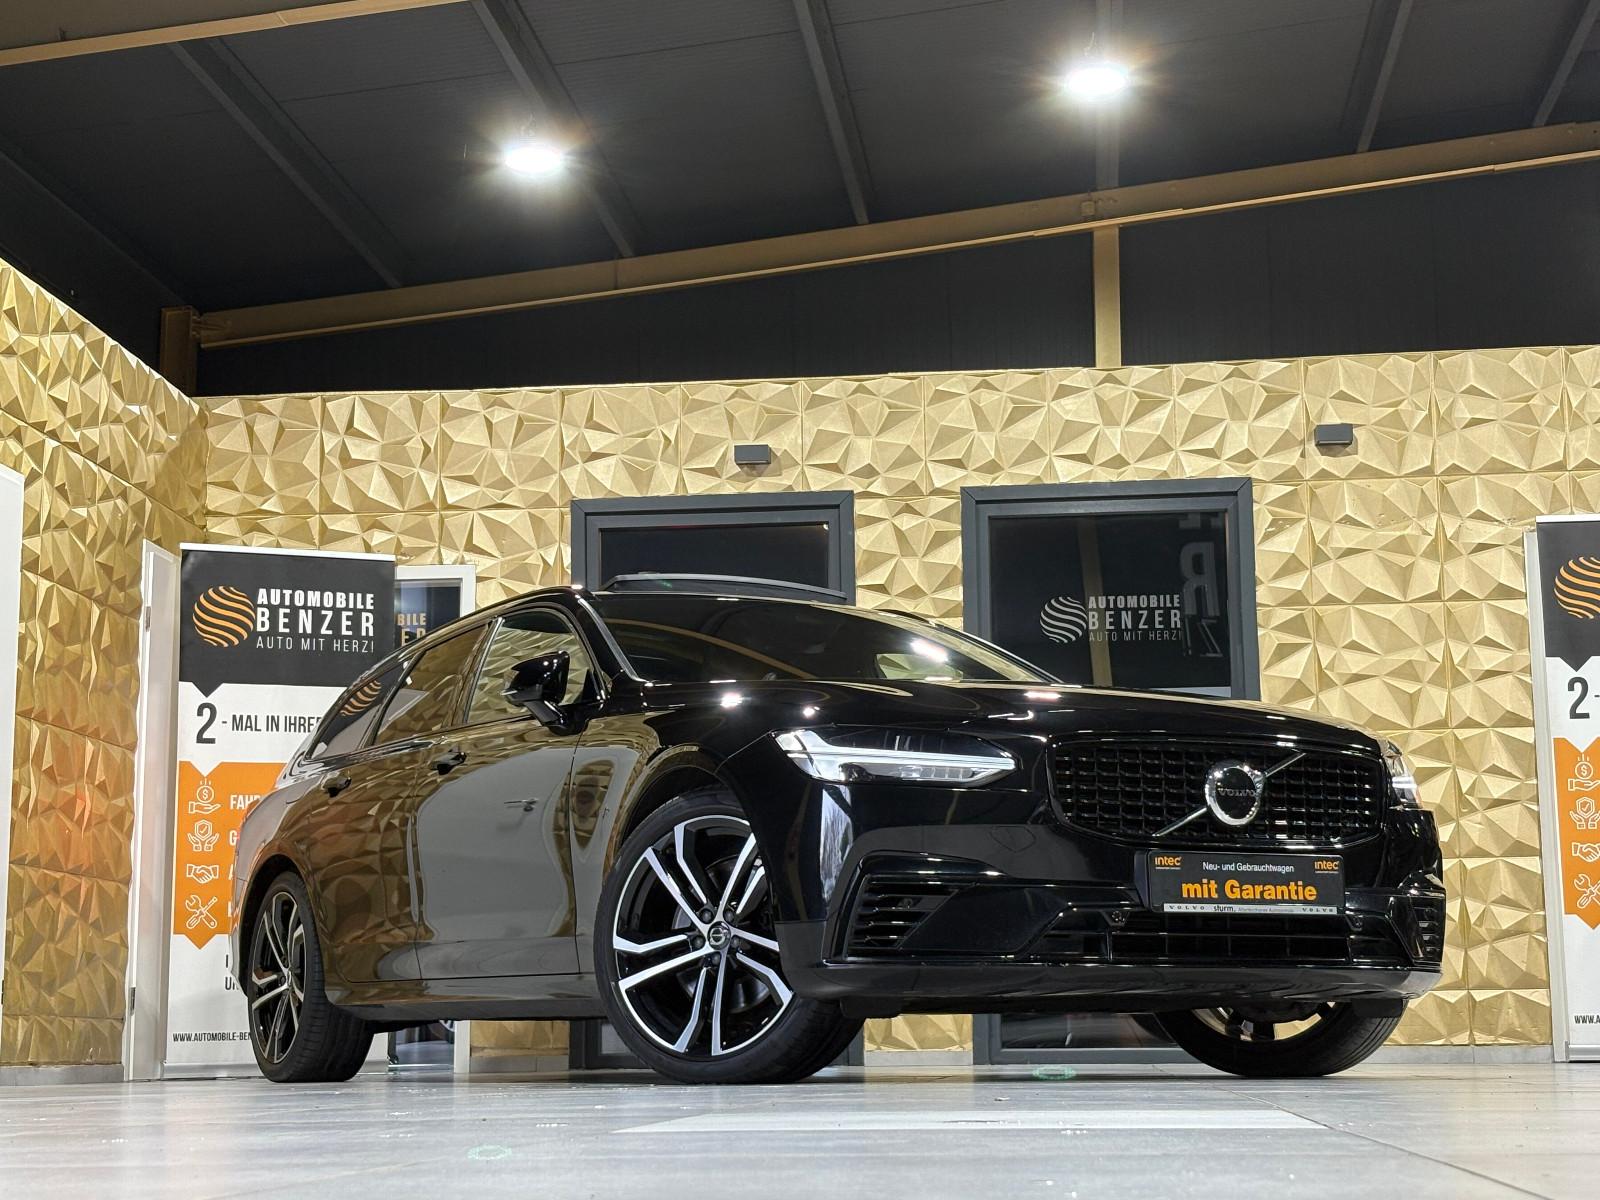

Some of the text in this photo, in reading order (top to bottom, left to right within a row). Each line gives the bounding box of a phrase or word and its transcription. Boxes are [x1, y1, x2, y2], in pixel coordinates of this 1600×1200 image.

[257, 588, 375, 610] AUTOMOBILE
[1088, 594, 1180, 609] AUTOMOBILE
[256, 608, 375, 637] BENZER
[1088, 609, 1181, 630] BENZER
[256, 636, 293, 650] AUTO
[301, 638, 325, 651] MIT
[1089, 631, 1117, 642] AUTO
[1123, 630, 1142, 641] MIT
[1567, 676, 1590, 720] 2
[196, 702, 217, 744] 2
[231, 714, 262, 732] MAL
[266, 715, 280, 732] IN
[1217, 787, 1256, 797] VOLVO
[1202, 861, 1295, 874] Neu- und Gebrauchtwagen
[1181, 878, 1318, 901] mit Garantie
